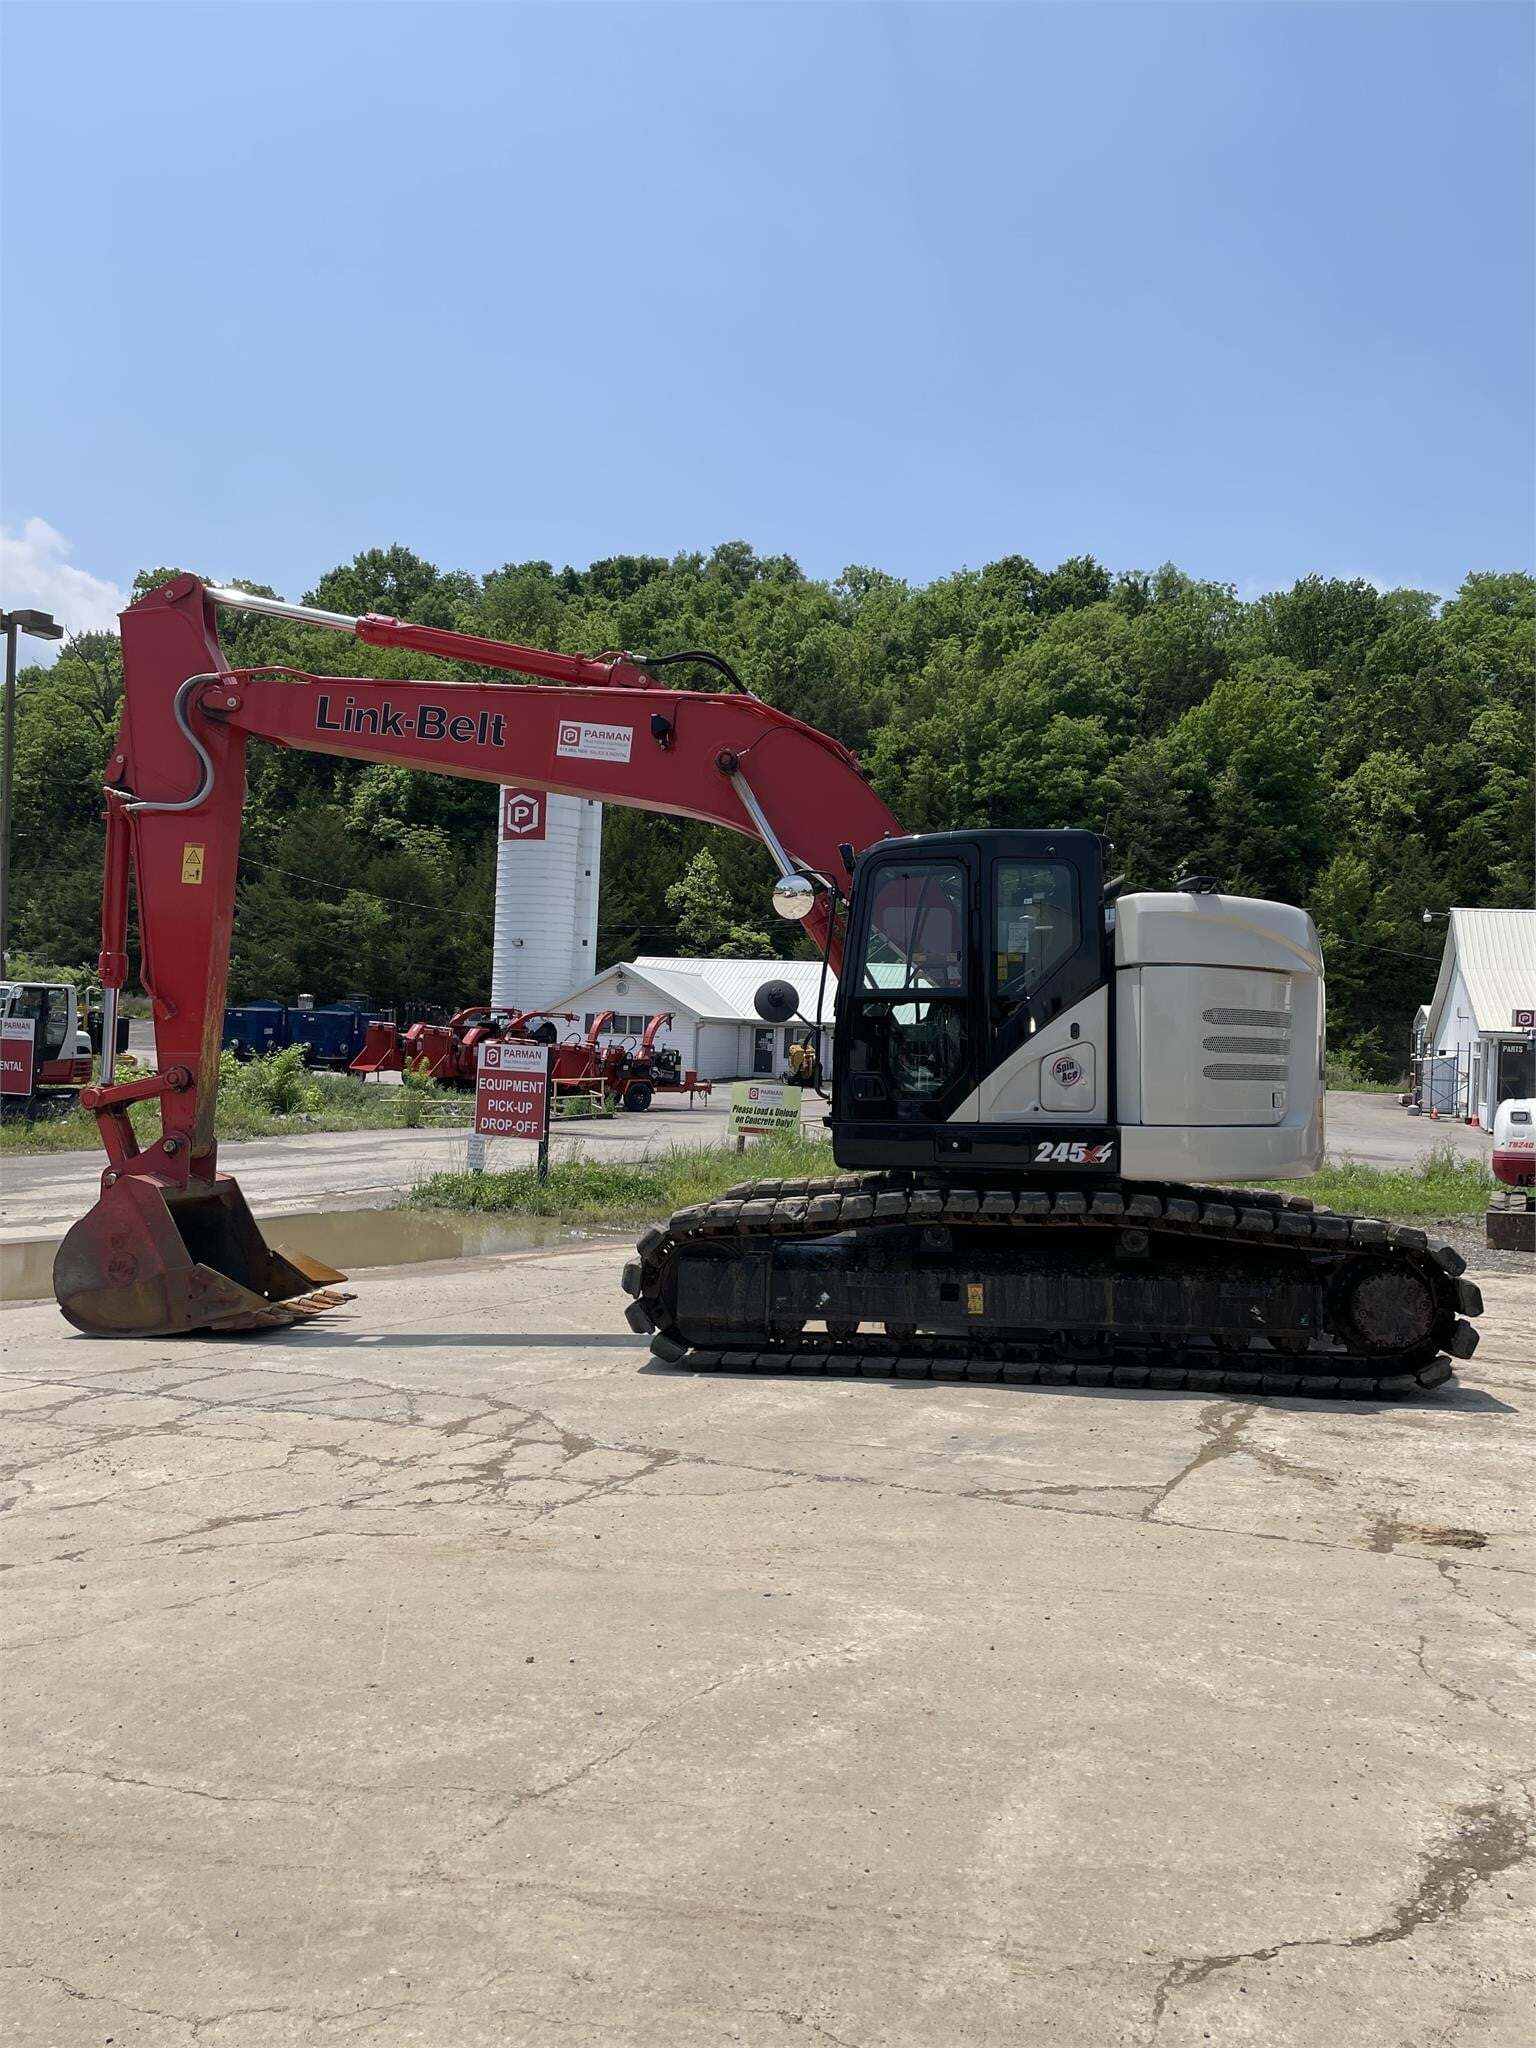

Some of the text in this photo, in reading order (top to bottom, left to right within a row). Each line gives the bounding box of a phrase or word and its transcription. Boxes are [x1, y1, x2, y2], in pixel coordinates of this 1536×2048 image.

[316, 694, 506, 747] Link-Belt
[584, 729, 631, 742] PARMAN
[514, 806, 529, 822] P
[4, 1022, 31, 1030] PARMAN
[503, 1049, 542, 1060] PARMAN
[1502, 1045, 1524, 1053] PARTS
[1056, 1060, 1075, 1074] Spin
[1062, 1070, 1078, 1082] Ace
[479, 1078, 544, 1093] EQUIPMENT
[487, 1099, 533, 1114] PICK-UP
[732, 1104, 753, 1114] Please
[753, 1106, 769, 1115] Load
[775, 1108, 798, 1118] Unload
[481, 1117, 539, 1133] DROP-OFF
[745, 1115, 774, 1126] Concrete
[775, 1118, 794, 1128] Only!
